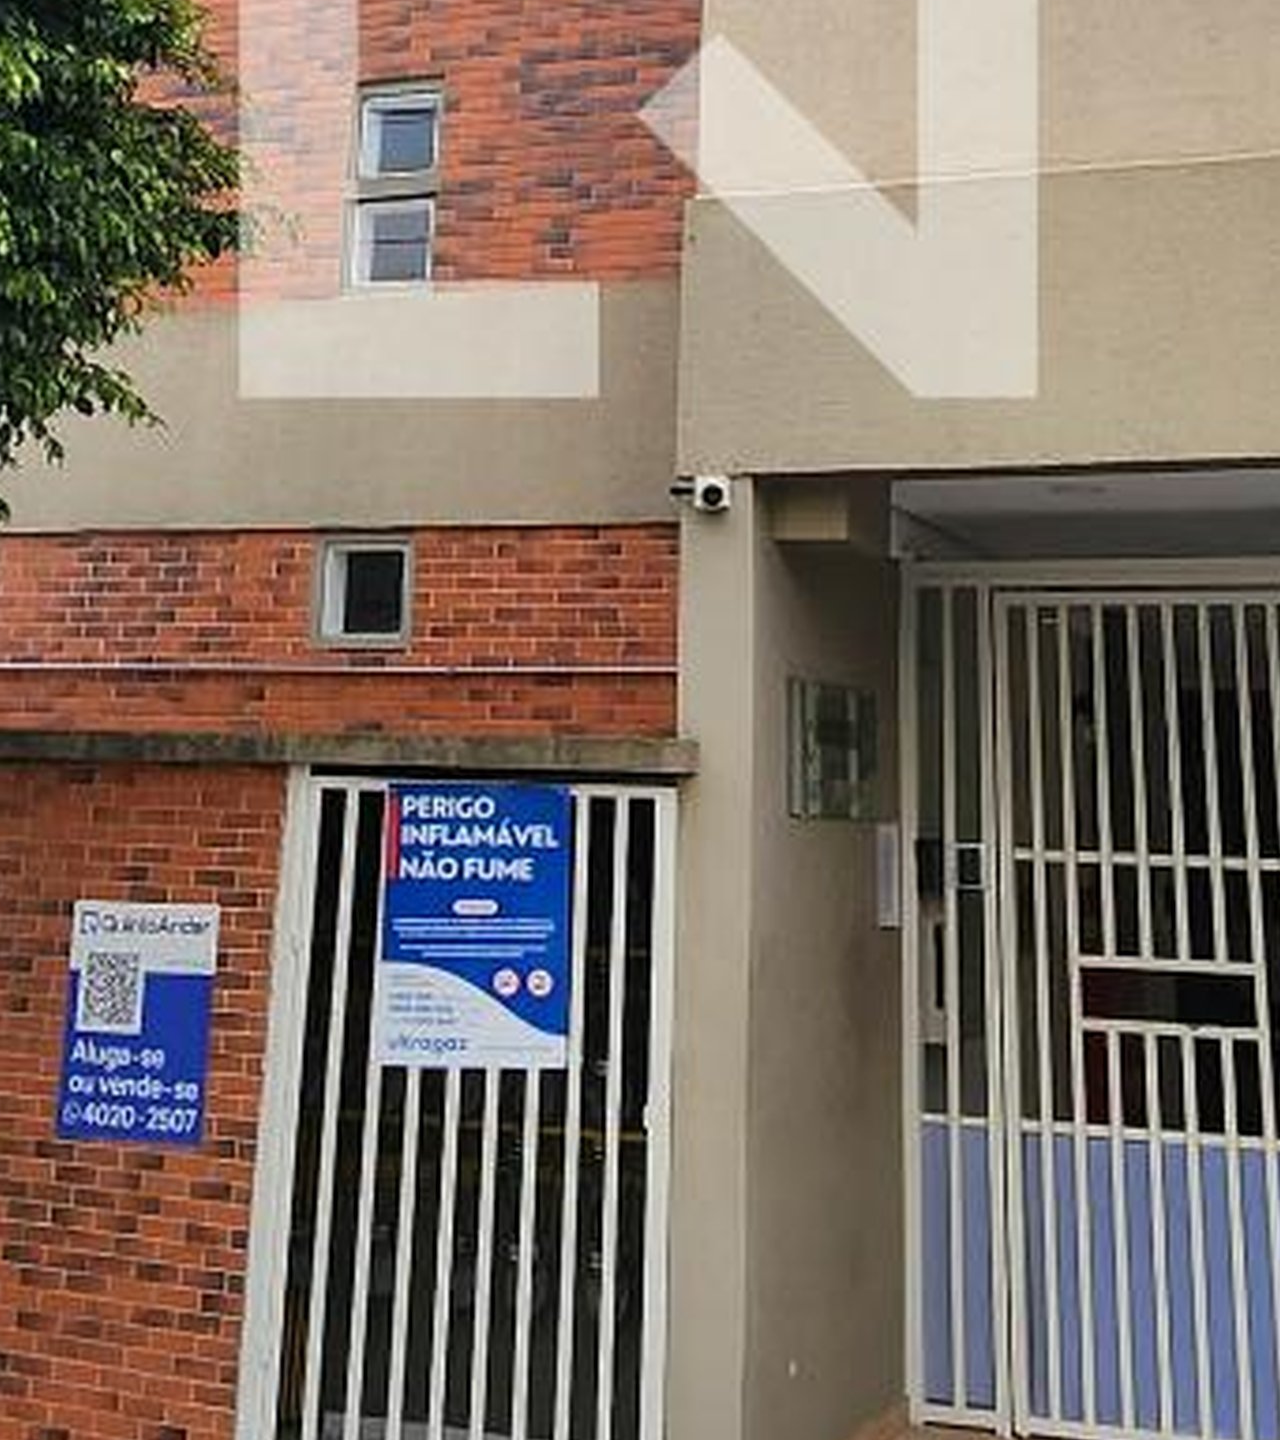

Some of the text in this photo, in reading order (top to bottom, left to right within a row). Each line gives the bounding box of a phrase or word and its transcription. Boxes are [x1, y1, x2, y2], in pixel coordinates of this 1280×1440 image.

[402, 795, 496, 819] PERIGO
[400, 818, 559, 848] INFLAMÁVEL
[400, 850, 535, 881] NÃO FUME
[72, 1038, 165, 1071] Aluga-se
[99, 1073, 199, 1101] vende-se
[84, 1101, 198, 1133] 4020-2507
